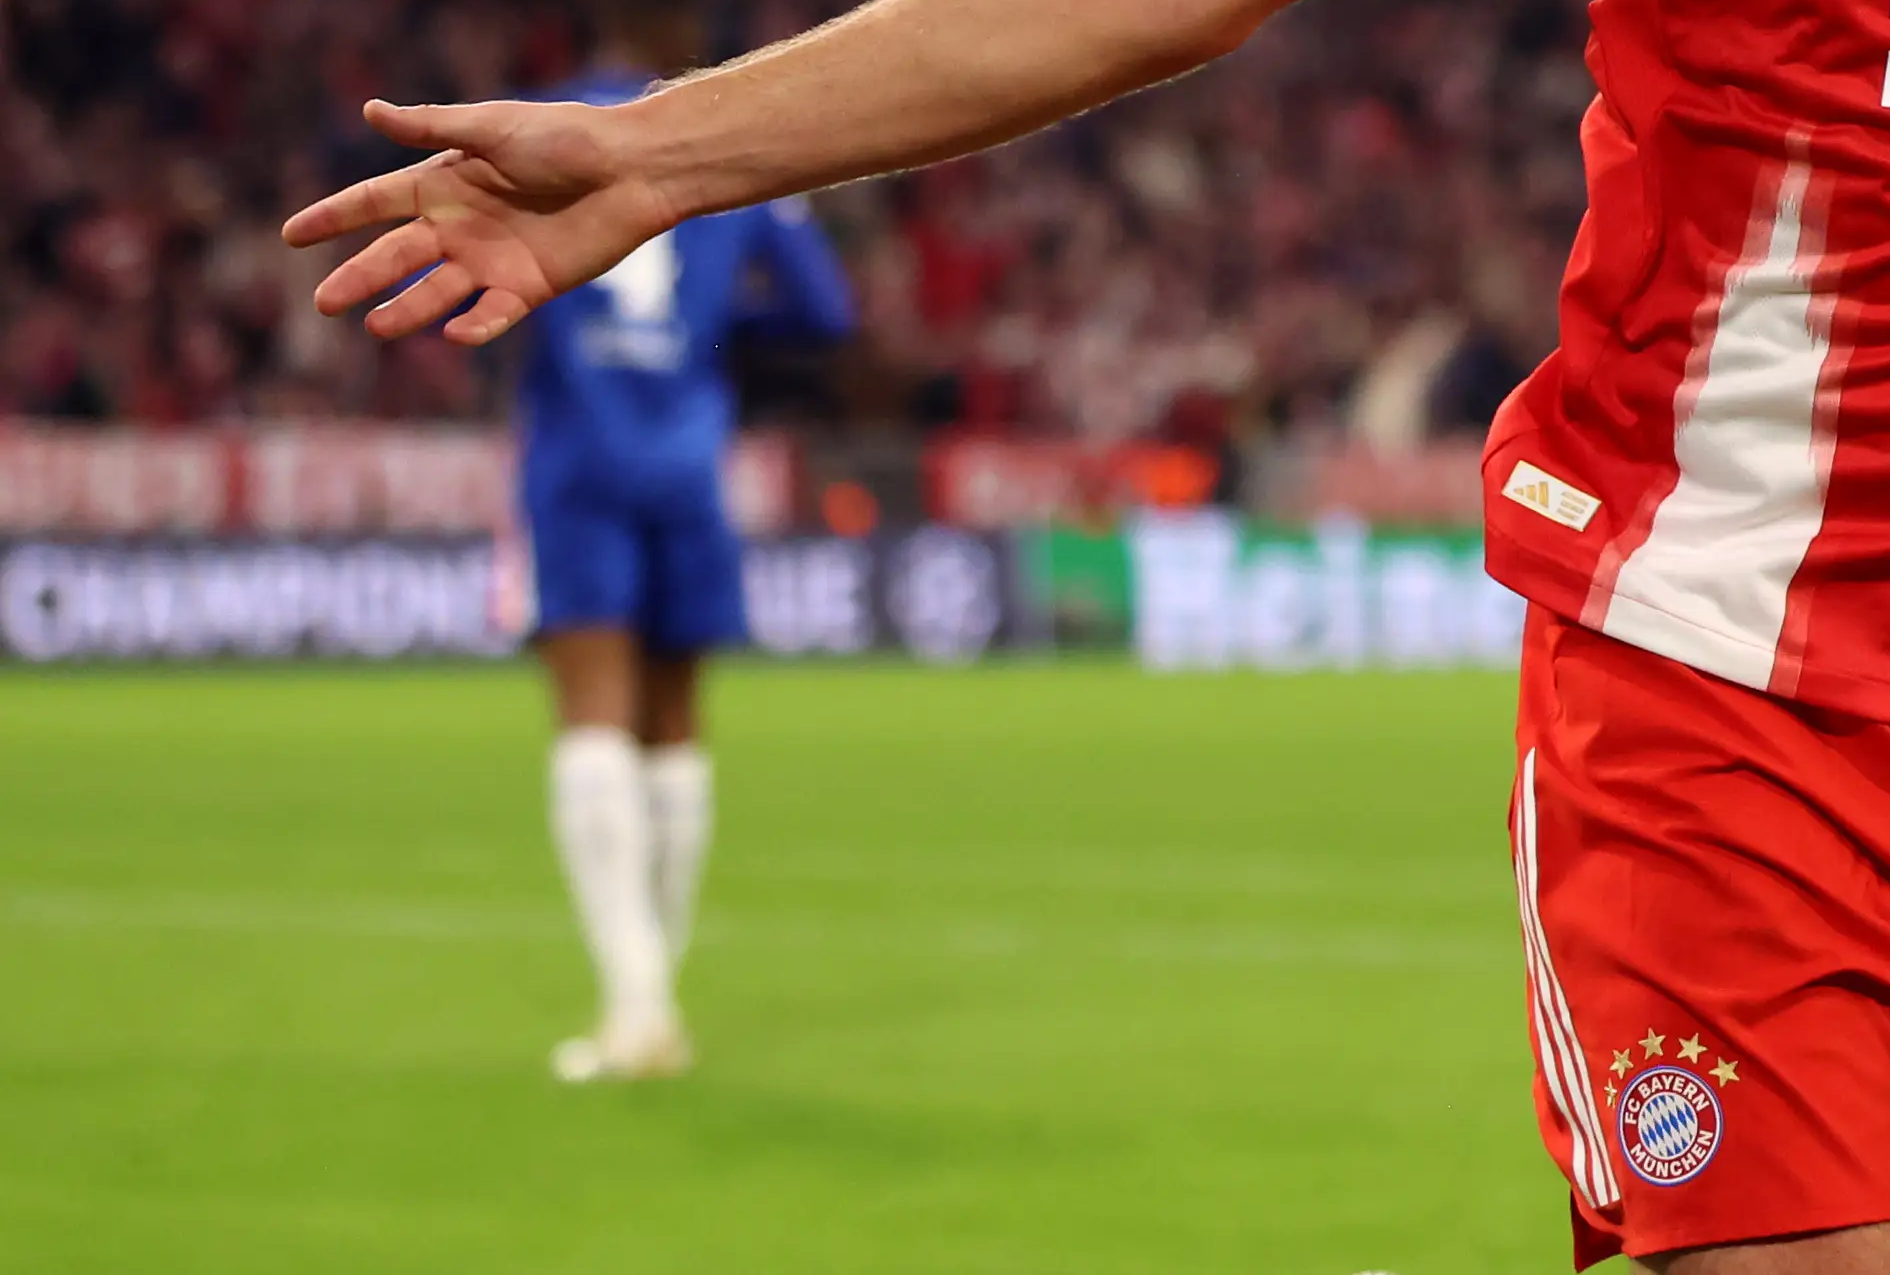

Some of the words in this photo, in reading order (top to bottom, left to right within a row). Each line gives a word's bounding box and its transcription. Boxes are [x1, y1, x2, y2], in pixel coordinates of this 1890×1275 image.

[3, 544, 495, 659] CHAMPION
[1624, 1097, 1641, 1125] FC
[1637, 1074, 1711, 1112] BAYERN
[1630, 1129, 1714, 1178] MÜNCHEN
